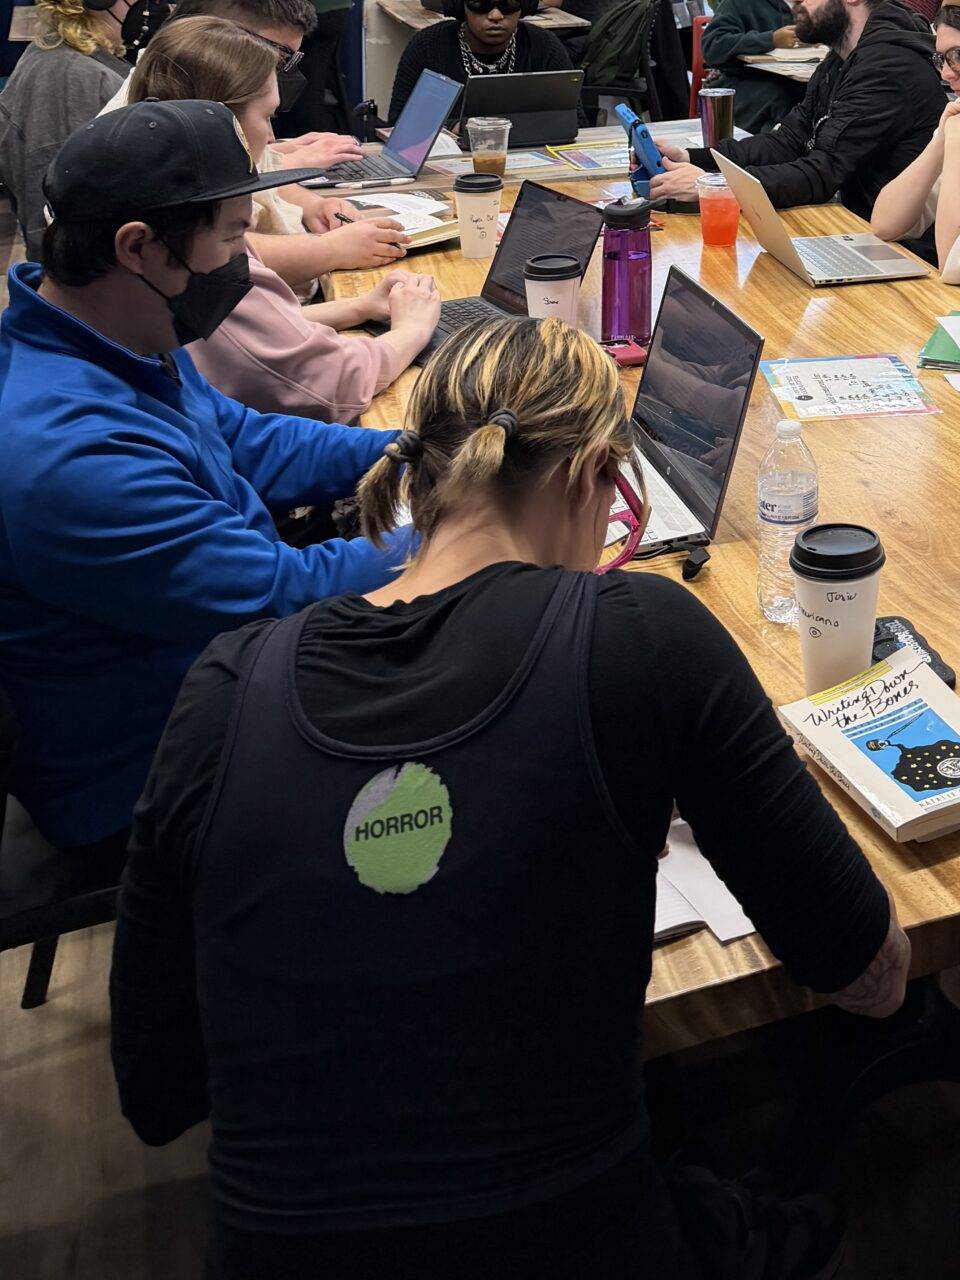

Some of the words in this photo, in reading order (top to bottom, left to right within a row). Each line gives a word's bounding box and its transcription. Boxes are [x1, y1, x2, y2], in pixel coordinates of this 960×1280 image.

[760, 499, 777, 512] ater
[803, 690, 872, 727] Writing
[864, 661, 925, 701] Down
[831, 713, 868, 728] the
[862, 681, 919, 718] Bones
[919, 792, 956, 808] NATALIE
[355, 806, 443, 841] HORROR
